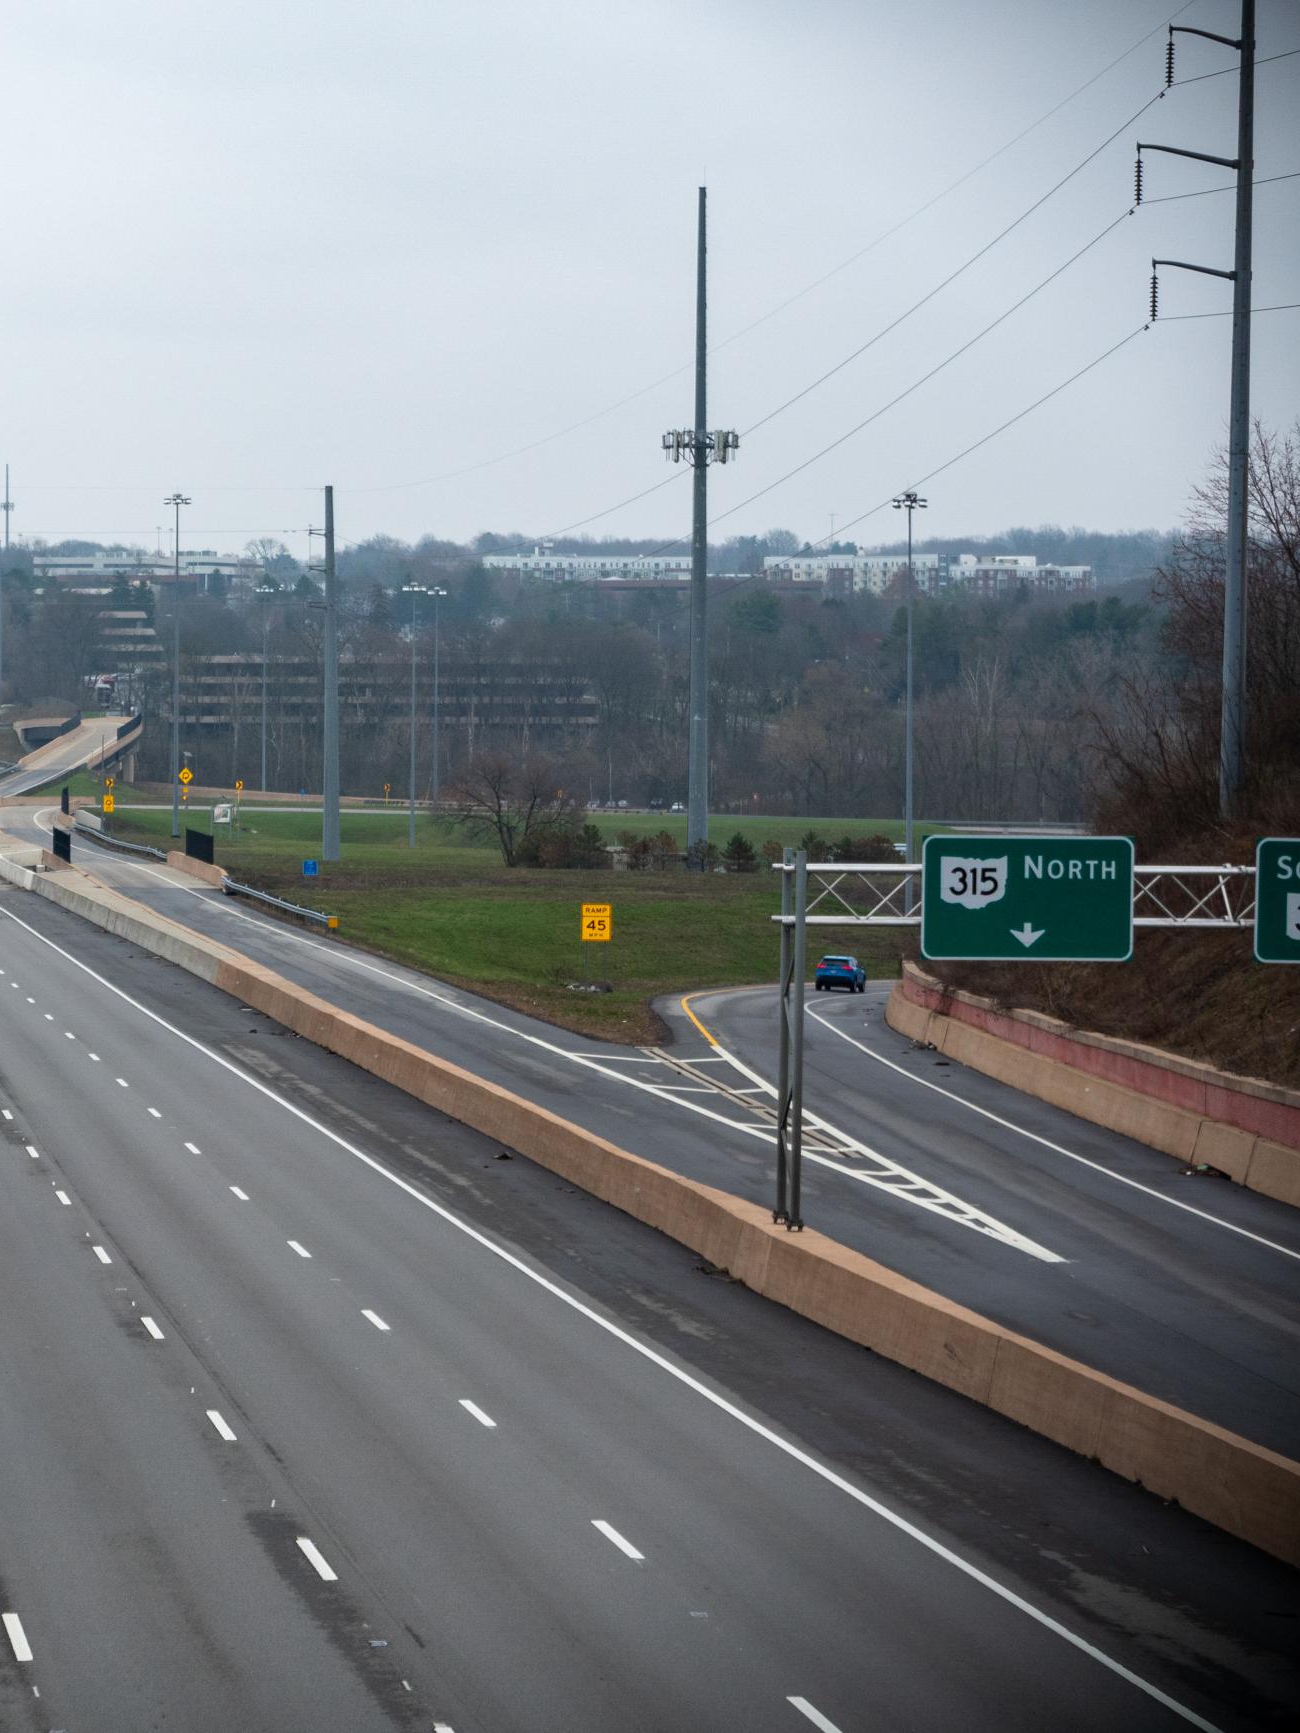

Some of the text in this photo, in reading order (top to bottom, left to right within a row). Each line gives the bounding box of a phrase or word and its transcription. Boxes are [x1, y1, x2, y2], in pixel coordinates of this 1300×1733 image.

[950, 855, 1116, 896] 315 NORTH
[1277, 855, 1300, 879] S
[586, 920, 606, 930] 45
